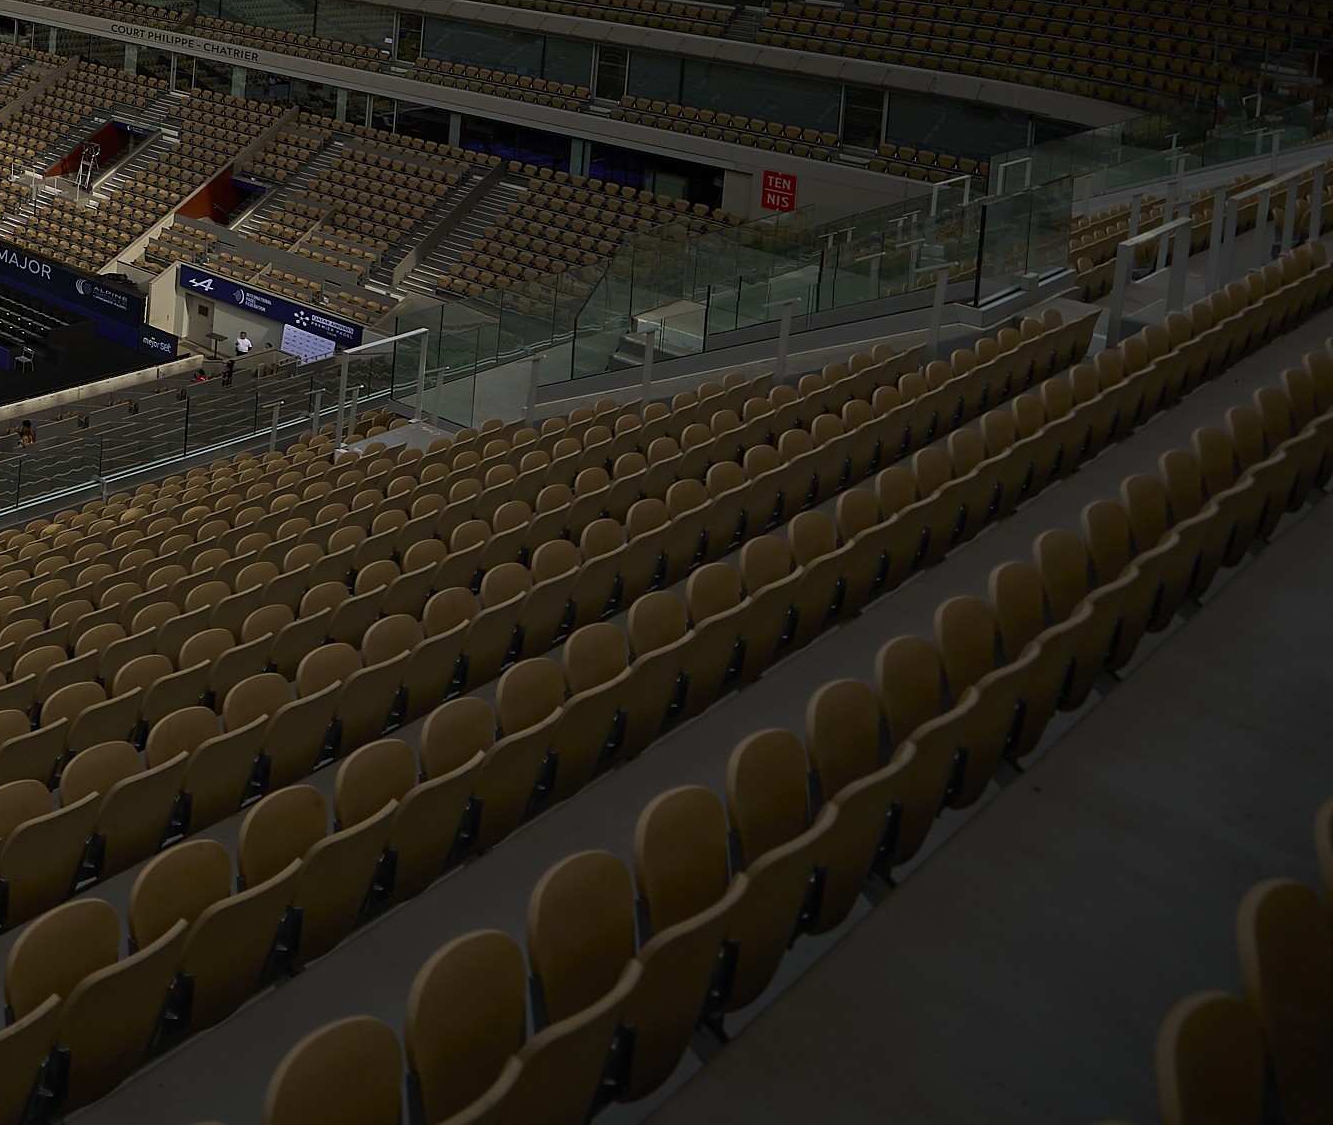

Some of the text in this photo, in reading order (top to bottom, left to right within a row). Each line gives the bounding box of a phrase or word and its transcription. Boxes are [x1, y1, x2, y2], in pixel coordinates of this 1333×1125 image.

[111, 24, 146, 38] COURT
[147, 31, 194, 49] PHILIPPE
[203, 43, 259, 62] CHATRIER
[767, 175, 791, 190] TEN
[766, 193, 790, 207] NIS
[93, 286, 128, 302] ALPINE
